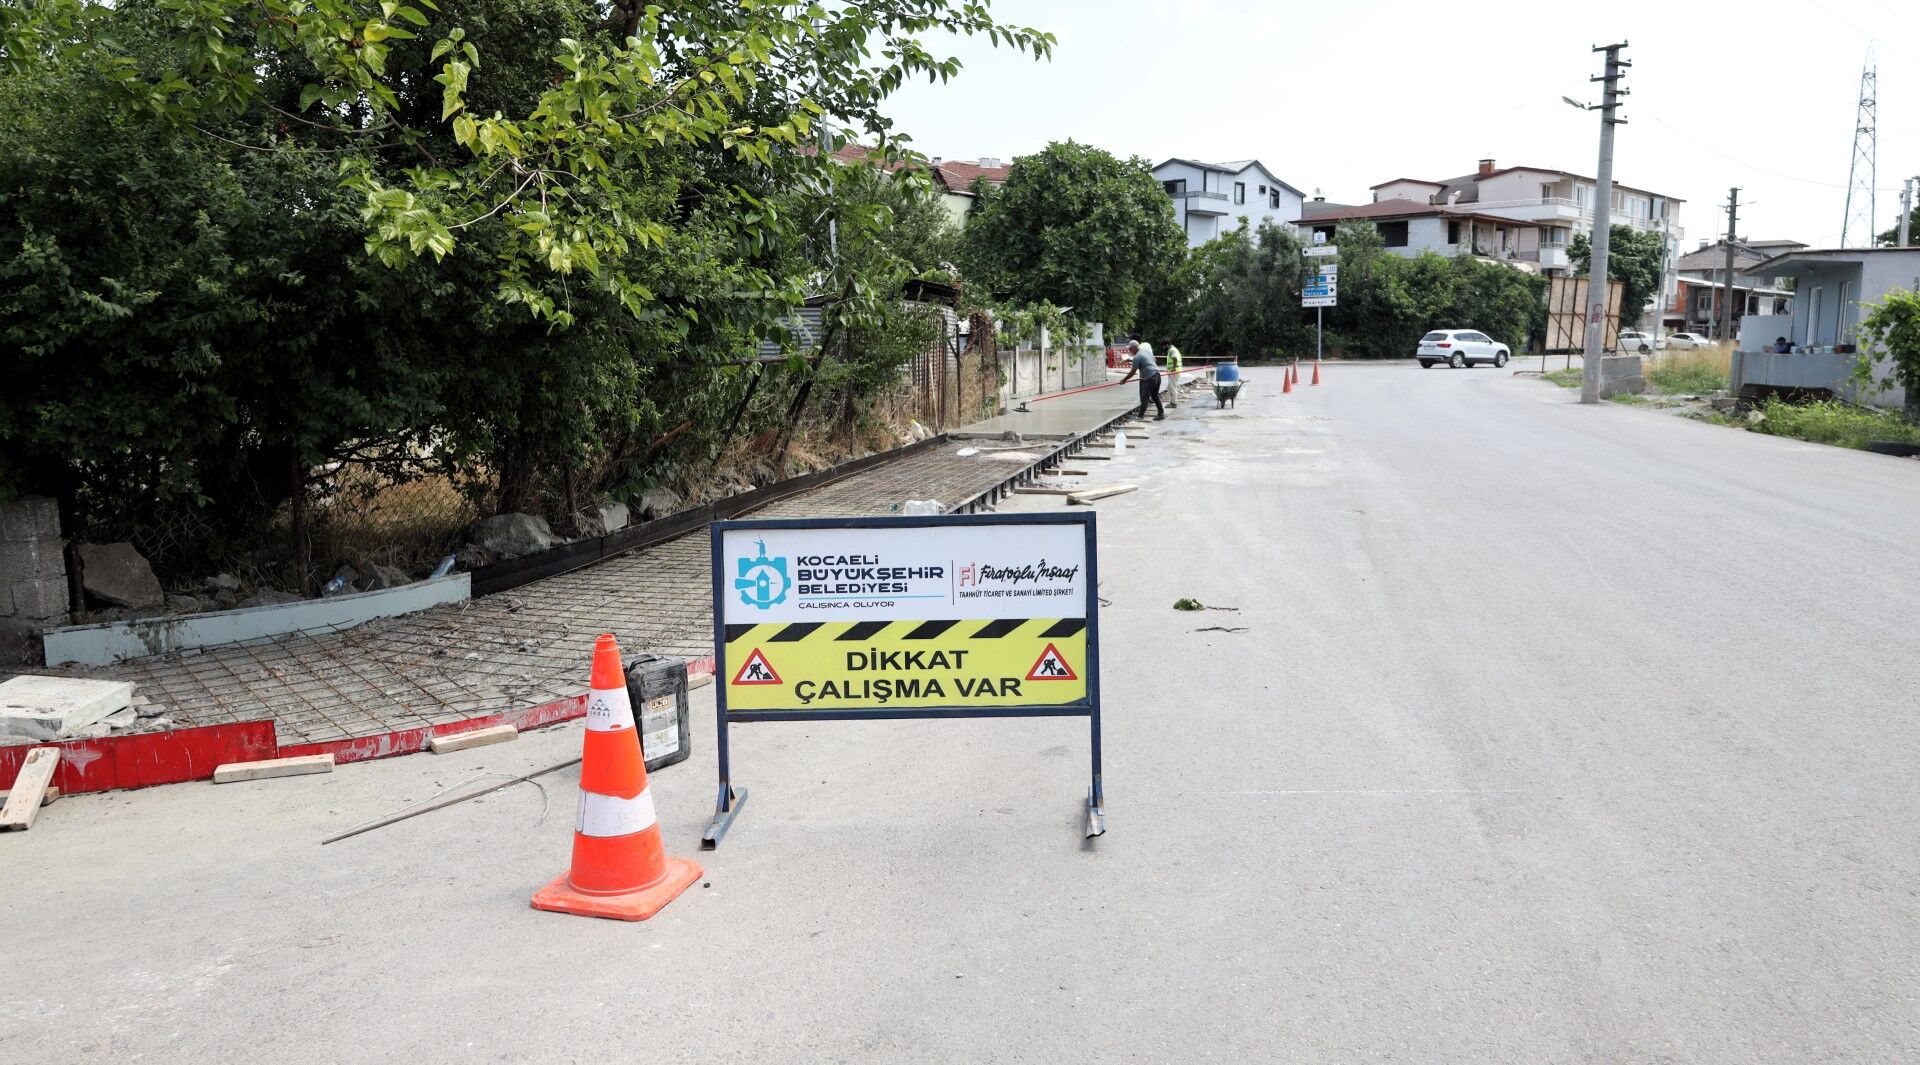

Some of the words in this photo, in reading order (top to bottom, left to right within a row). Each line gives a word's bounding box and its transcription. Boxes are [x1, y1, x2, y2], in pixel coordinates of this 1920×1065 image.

[959, 590, 983, 598] TAAHHÜT
[983, 589, 1004, 597] TİCARET
[1032, 588, 1053, 596] LİMİTED
[1053, 587, 1074, 596] ŞİRKETİ
[846, 647, 969, 671] DİKKAT
[794, 678, 946, 704] ÇALIŞMA
[954, 677, 1023, 697] VAR
[652, 698, 668, 709] JCB
